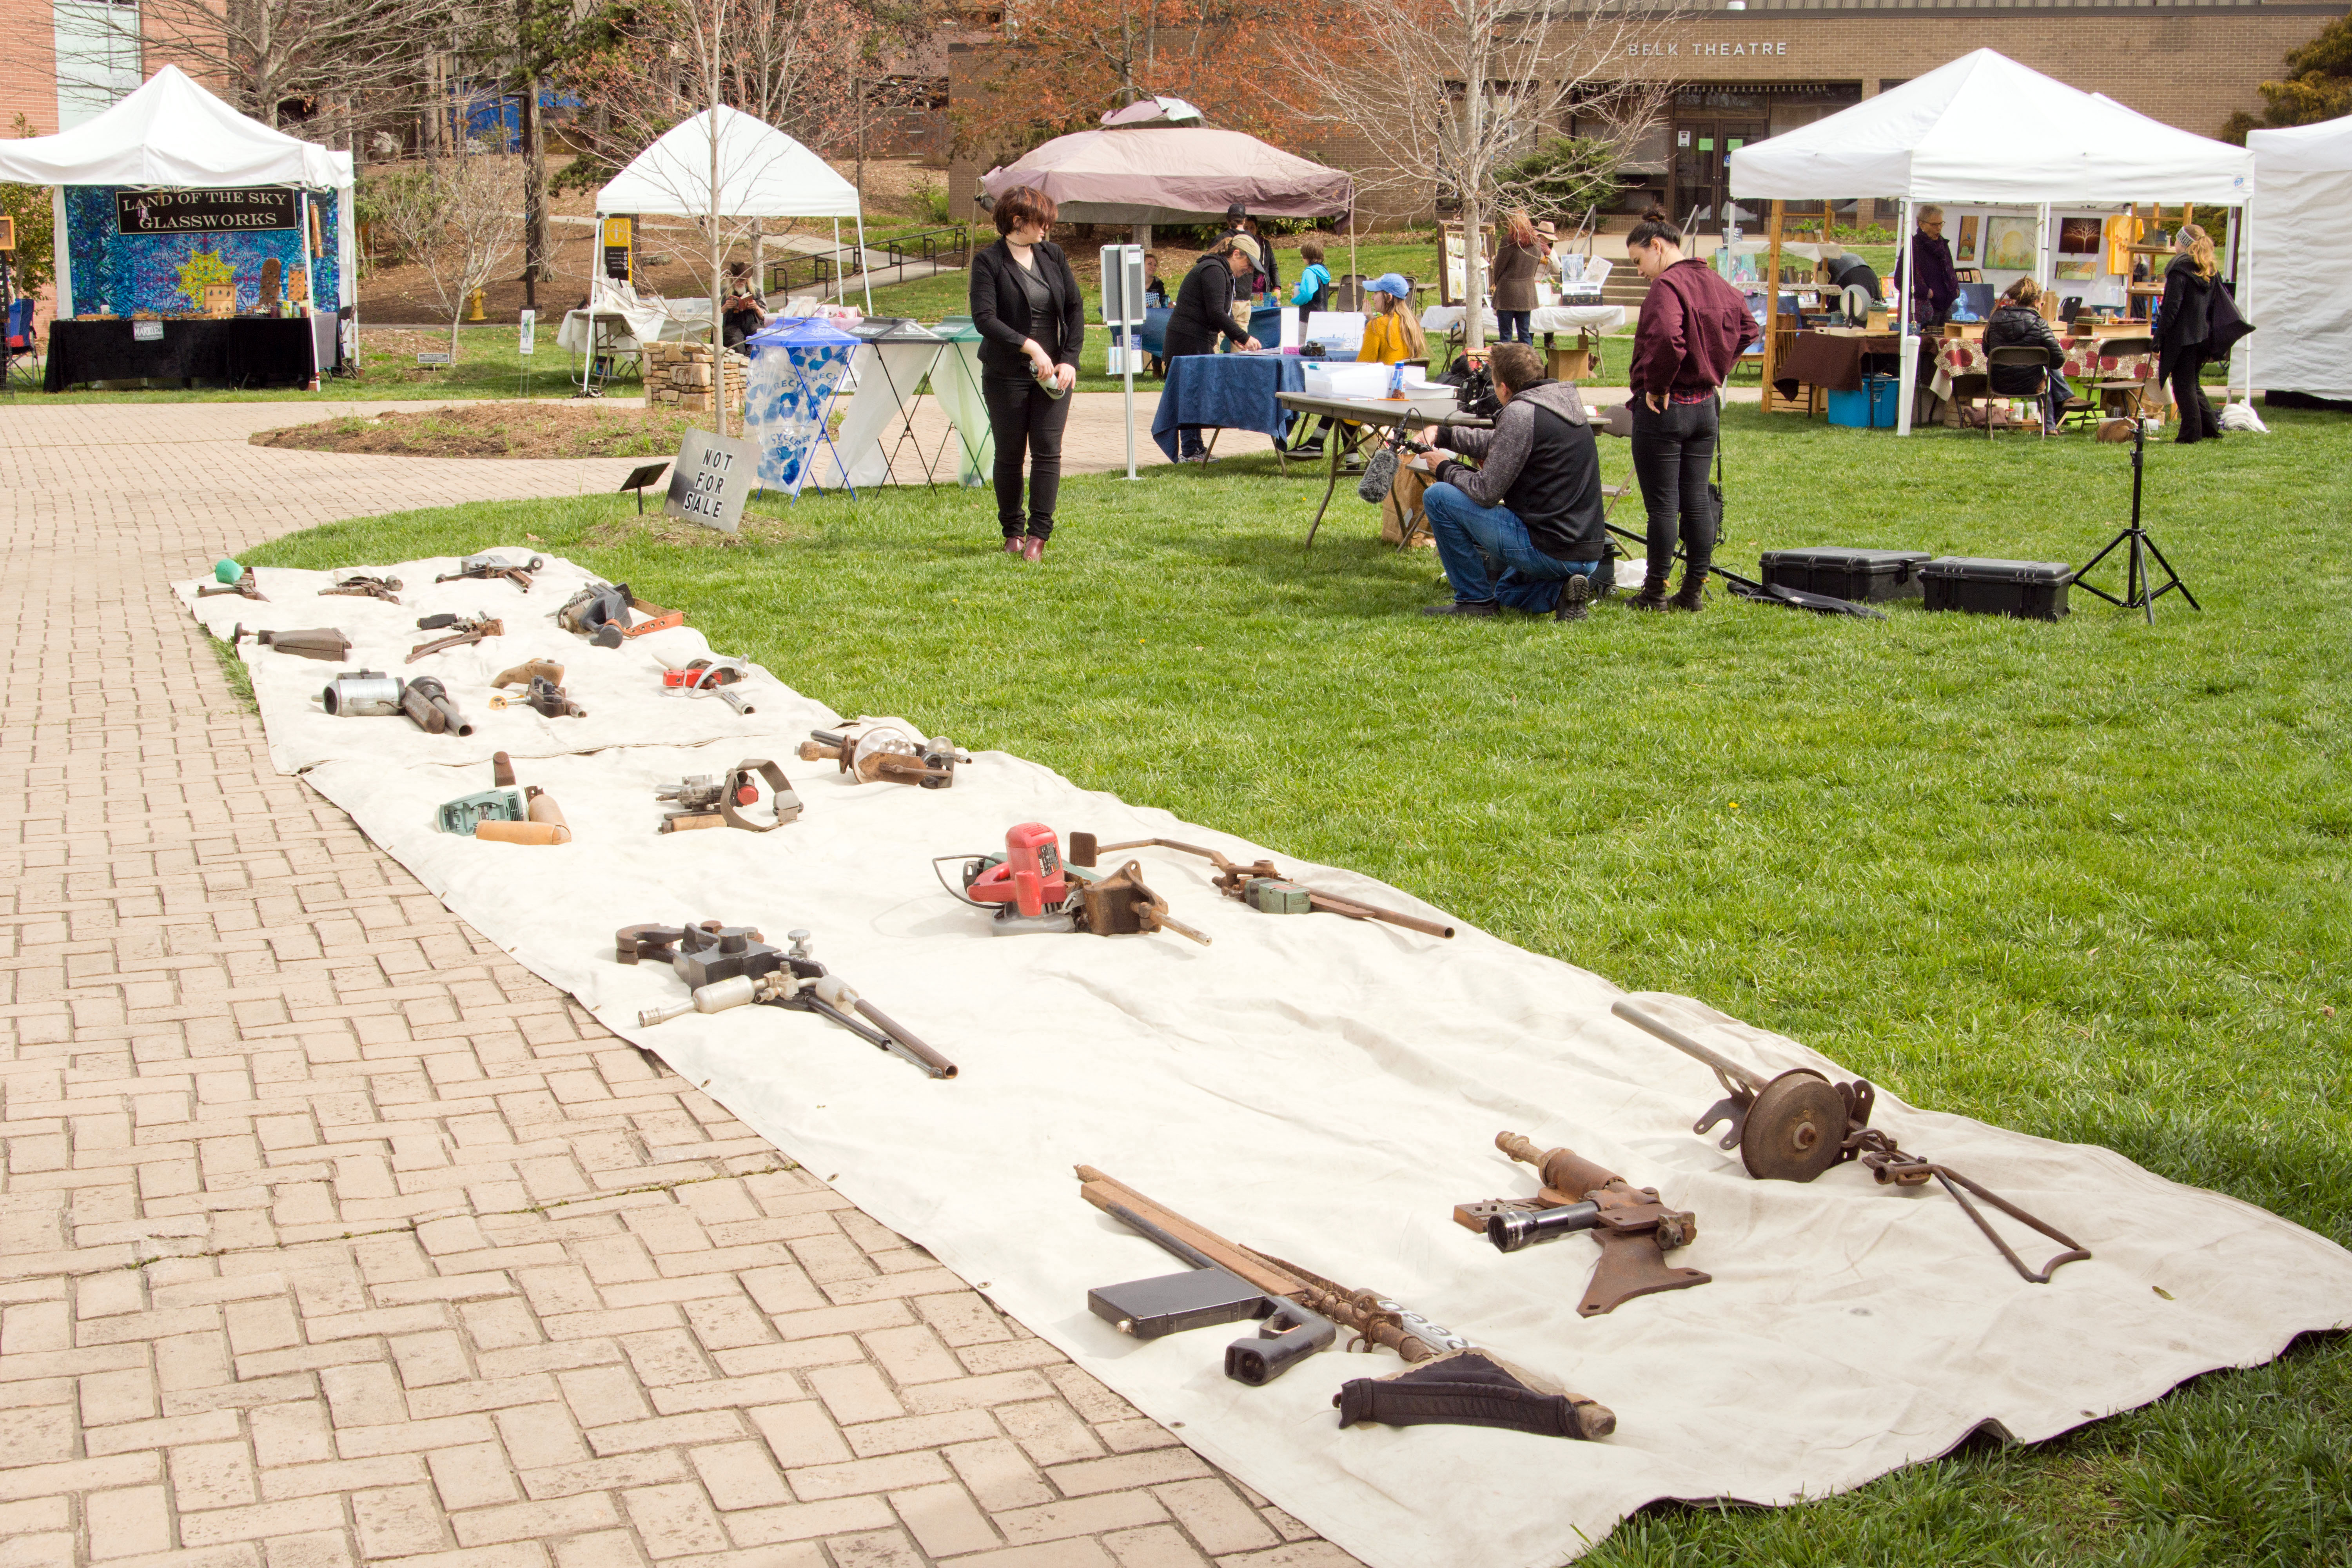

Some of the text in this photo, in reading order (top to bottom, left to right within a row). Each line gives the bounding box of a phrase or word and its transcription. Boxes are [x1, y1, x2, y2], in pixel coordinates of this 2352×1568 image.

[1628, 43, 1787, 56] BELK THEATRE
[123, 192, 287, 212] LAND OF THE SKY
[139, 213, 277, 229] GLASSWORKS
[134, 326, 162, 336] MARBLES
[702, 449, 733, 470] NOT
[695, 472, 724, 494] FOR
[684, 493, 722, 518] SALE
